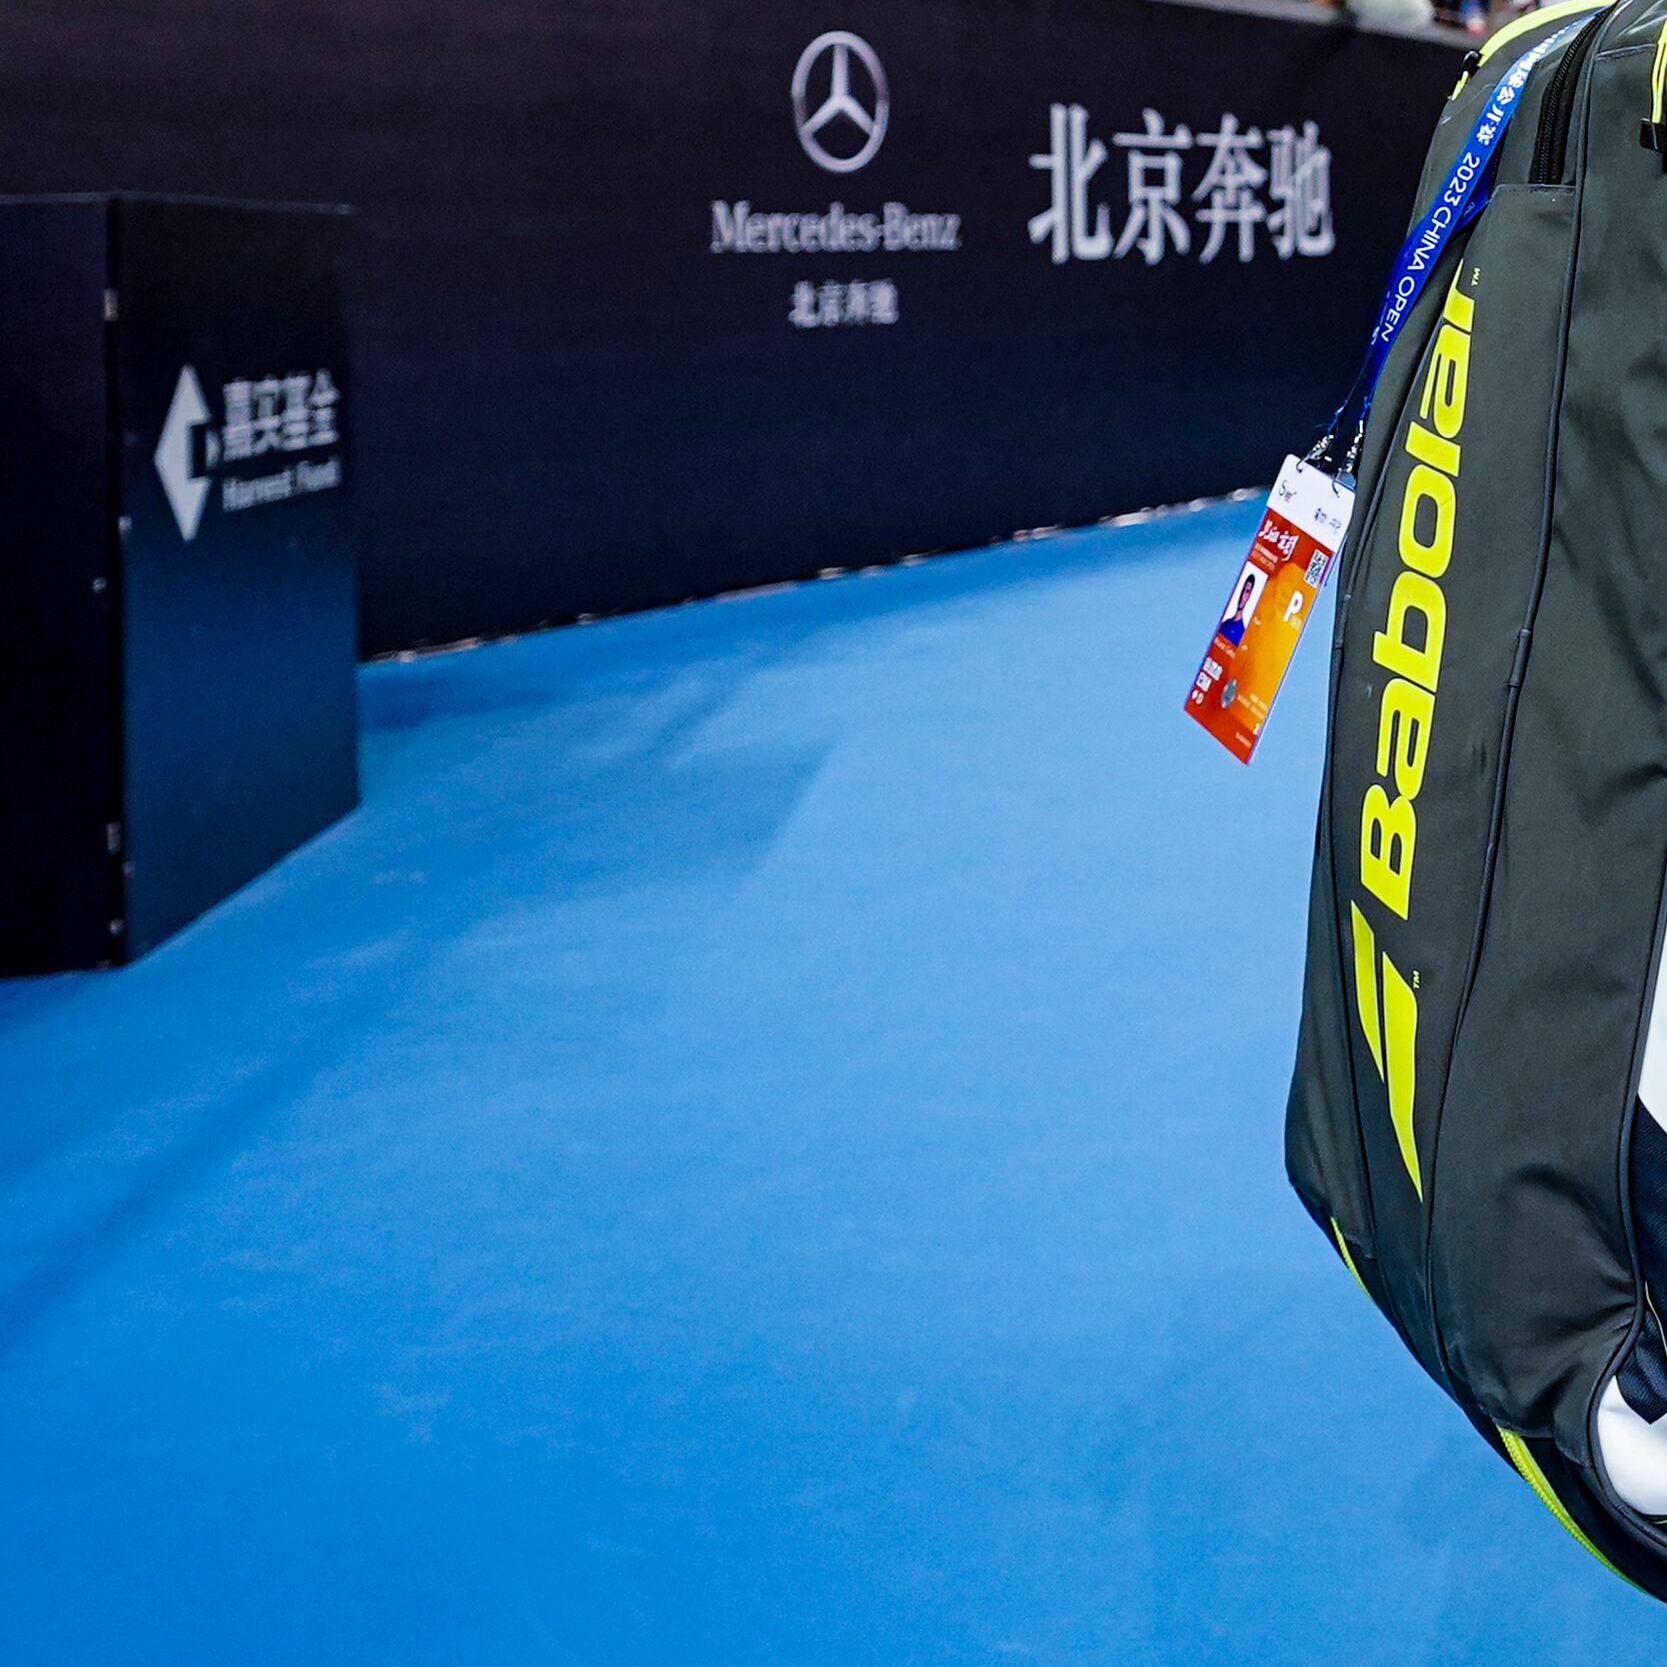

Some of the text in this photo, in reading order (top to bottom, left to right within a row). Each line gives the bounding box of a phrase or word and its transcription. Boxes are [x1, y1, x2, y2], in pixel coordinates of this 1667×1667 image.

[710, 200, 962, 253] Mercedes-Benz
[1027, 102, 1336, 265] 北京奔驰
[1381, 152, 1480, 342] 2023 CHINA OPEN
